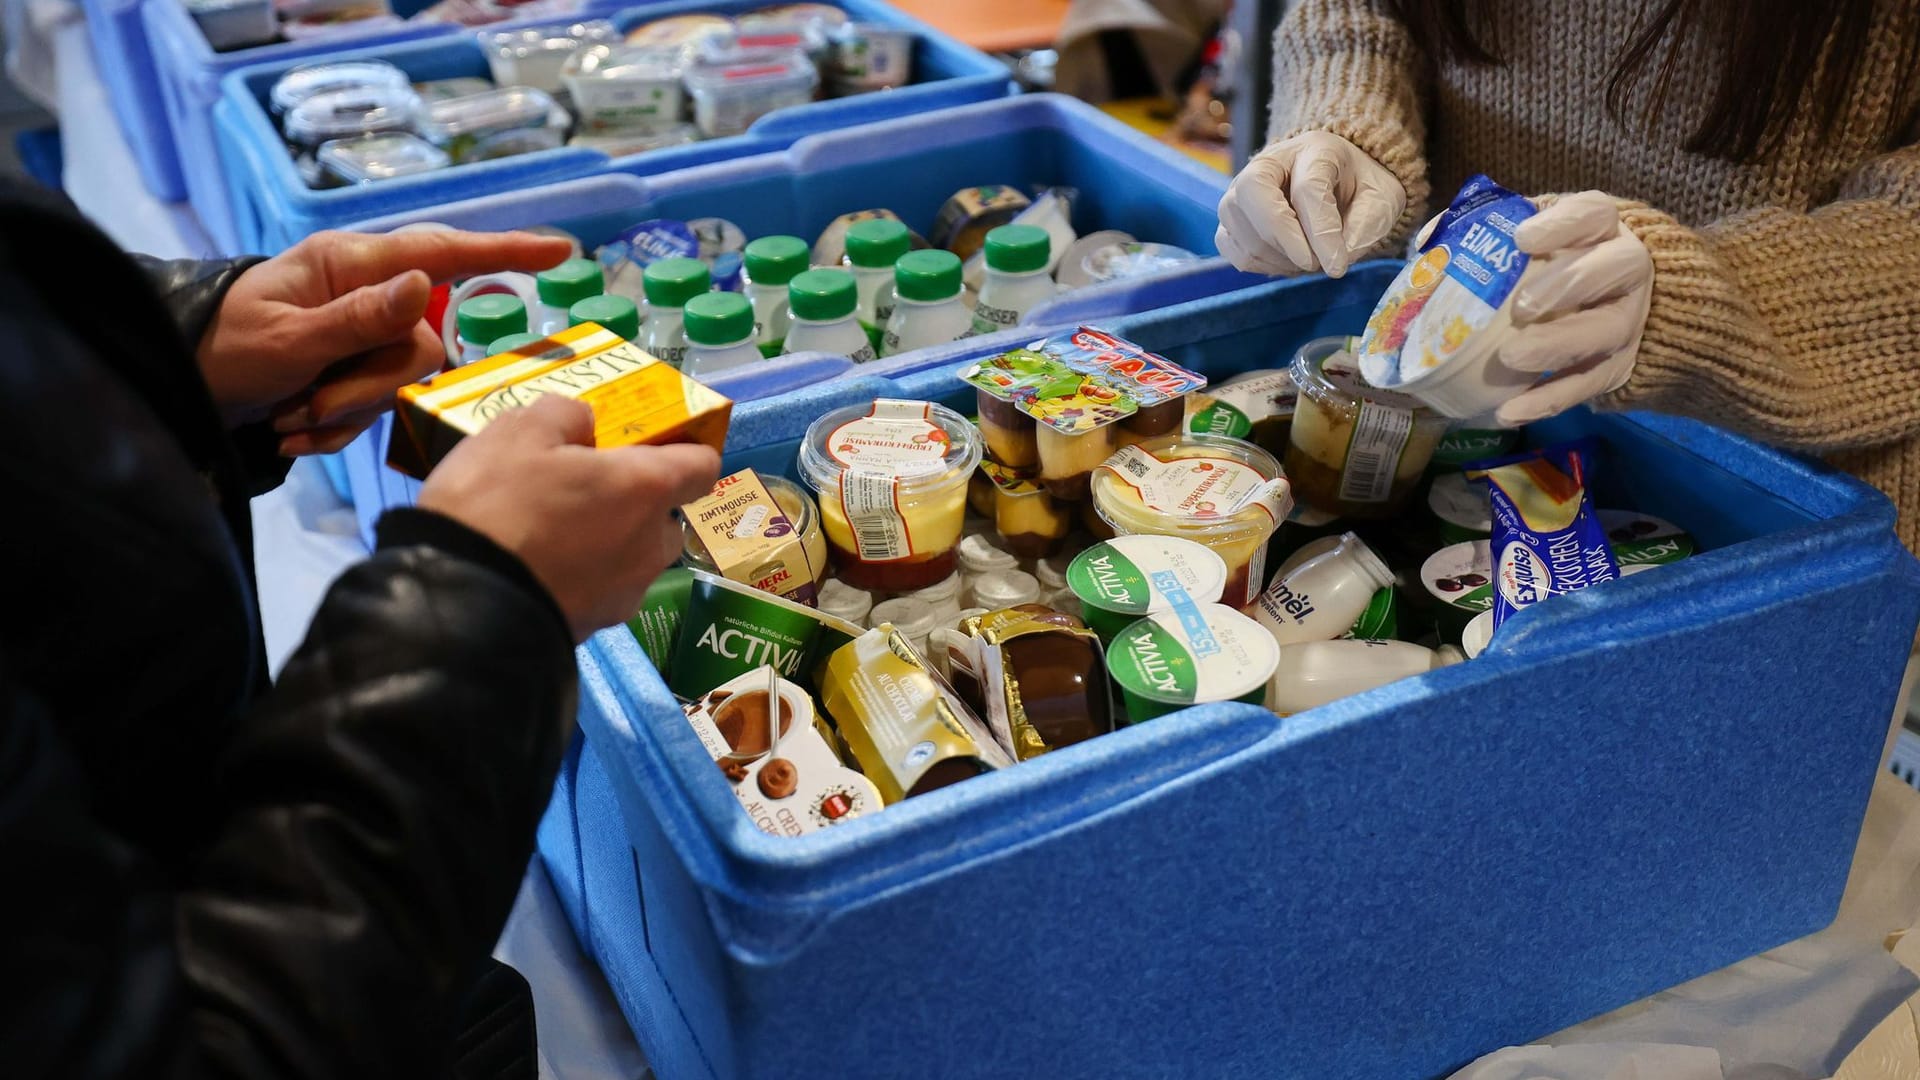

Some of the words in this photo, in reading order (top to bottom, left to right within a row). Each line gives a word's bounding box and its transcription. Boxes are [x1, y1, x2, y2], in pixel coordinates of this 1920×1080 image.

[1459, 223, 1520, 273] ELINAS
[698, 490, 759, 523] ZIMTMOUSSE
[1088, 555, 1136, 605] ACTIVIA
[1513, 546, 1538, 606] Exquisa
[725, 616, 759, 632] natürliche
[1130, 632, 1183, 692] ACTIVIA
